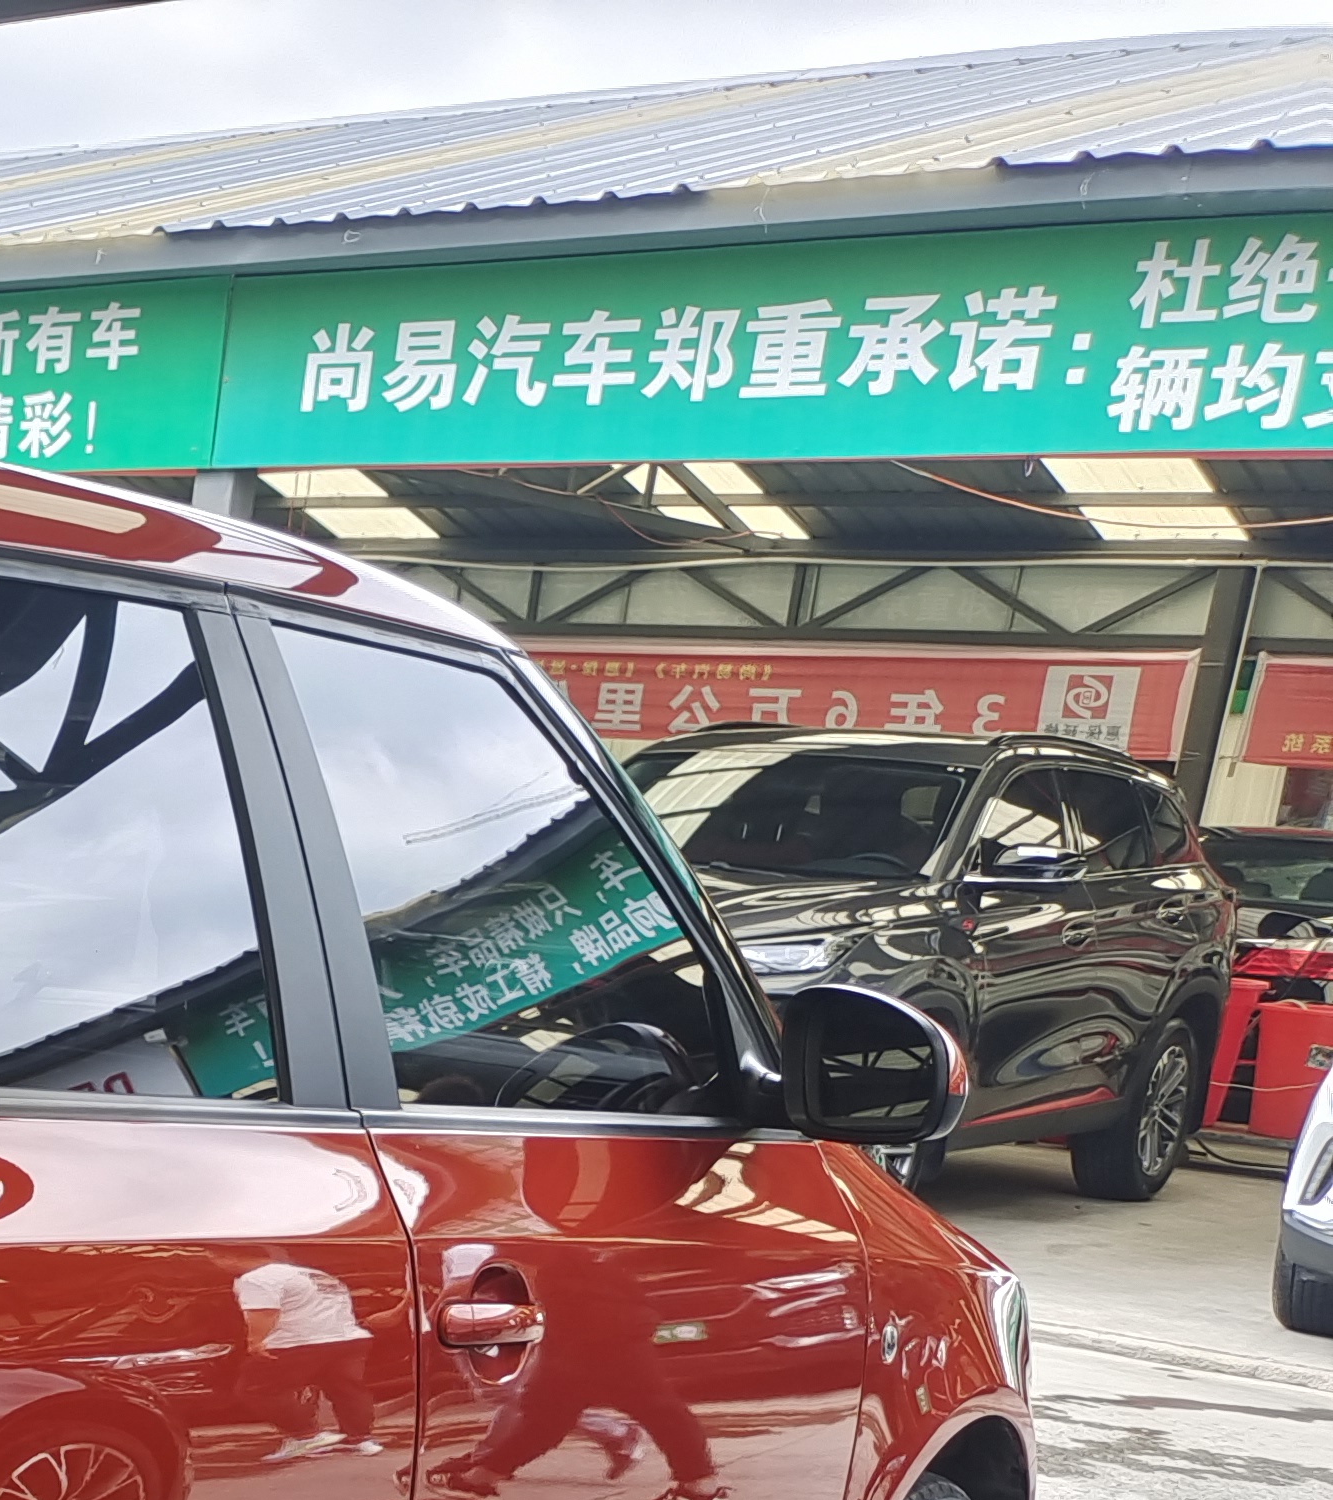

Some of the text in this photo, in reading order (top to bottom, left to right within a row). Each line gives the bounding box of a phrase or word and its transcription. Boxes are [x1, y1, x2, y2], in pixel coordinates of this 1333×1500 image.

[1129, 233, 1333, 329] 杜绝
[300, 285, 1092, 414] 尚易汽车郑重承诺：
